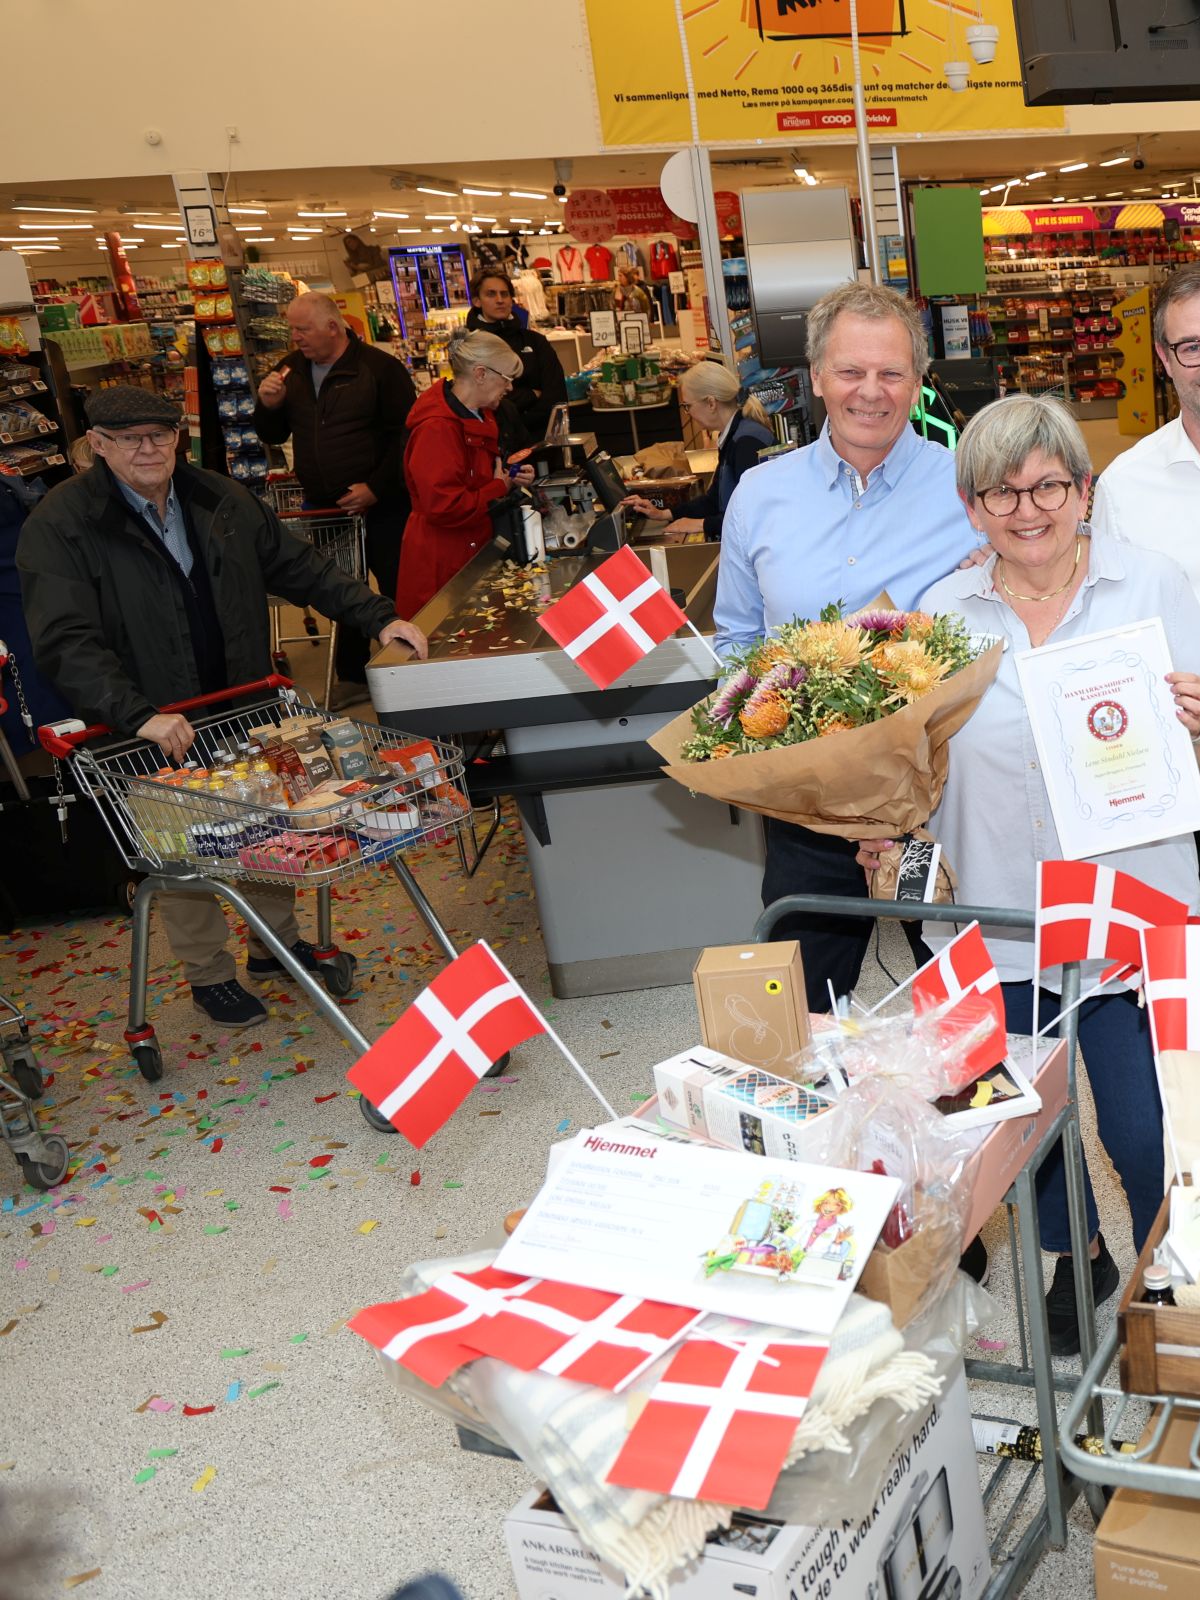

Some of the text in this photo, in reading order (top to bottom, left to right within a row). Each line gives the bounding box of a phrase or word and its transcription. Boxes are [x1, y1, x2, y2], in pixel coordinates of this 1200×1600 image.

[614, 94, 624, 102] Vi
[626, 91, 693, 102] sammenligne
[698, 90, 718, 98] med
[720, 89, 749, 98] Netto,
[752, 87, 778, 96] Rema
[781, 85, 804, 95] 1000
[807, 86, 818, 95] og
[820, 83, 879, 95] 365disunt
[881, 84, 893, 92] og
[896, 81, 933, 91] matcher
[822, 114, 852, 124] coop
[865, 114, 891, 123] vickly
[1035, 217, 1049, 225] LIFE
[1058, 215, 1084, 224] SWEET!
[1184, 213, 1200, 222] King
[1064, 684, 1103, 699] DANMARKS
[312, 765, 330, 776] MÆLK
[1109, 792, 1146, 807] Hjemmet
[584, 1135, 658, 1160] Hjemmet
[833, 1553, 848, 1579] to
[880, 1450, 912, 1506] really
[912, 1403, 941, 1454] hard.
[522, 1539, 602, 1563] ANKARSRUM
[549, 1562, 573, 1571] kitchen
[800, 1529, 840, 1592] tough
[526, 1564, 543, 1573] Made
[553, 1569, 568, 1578] work
[569, 1572, 588, 1583] really
[1110, 1561, 1160, 1580] Pure 600
[1111, 1572, 1169, 1592] Air purifier
